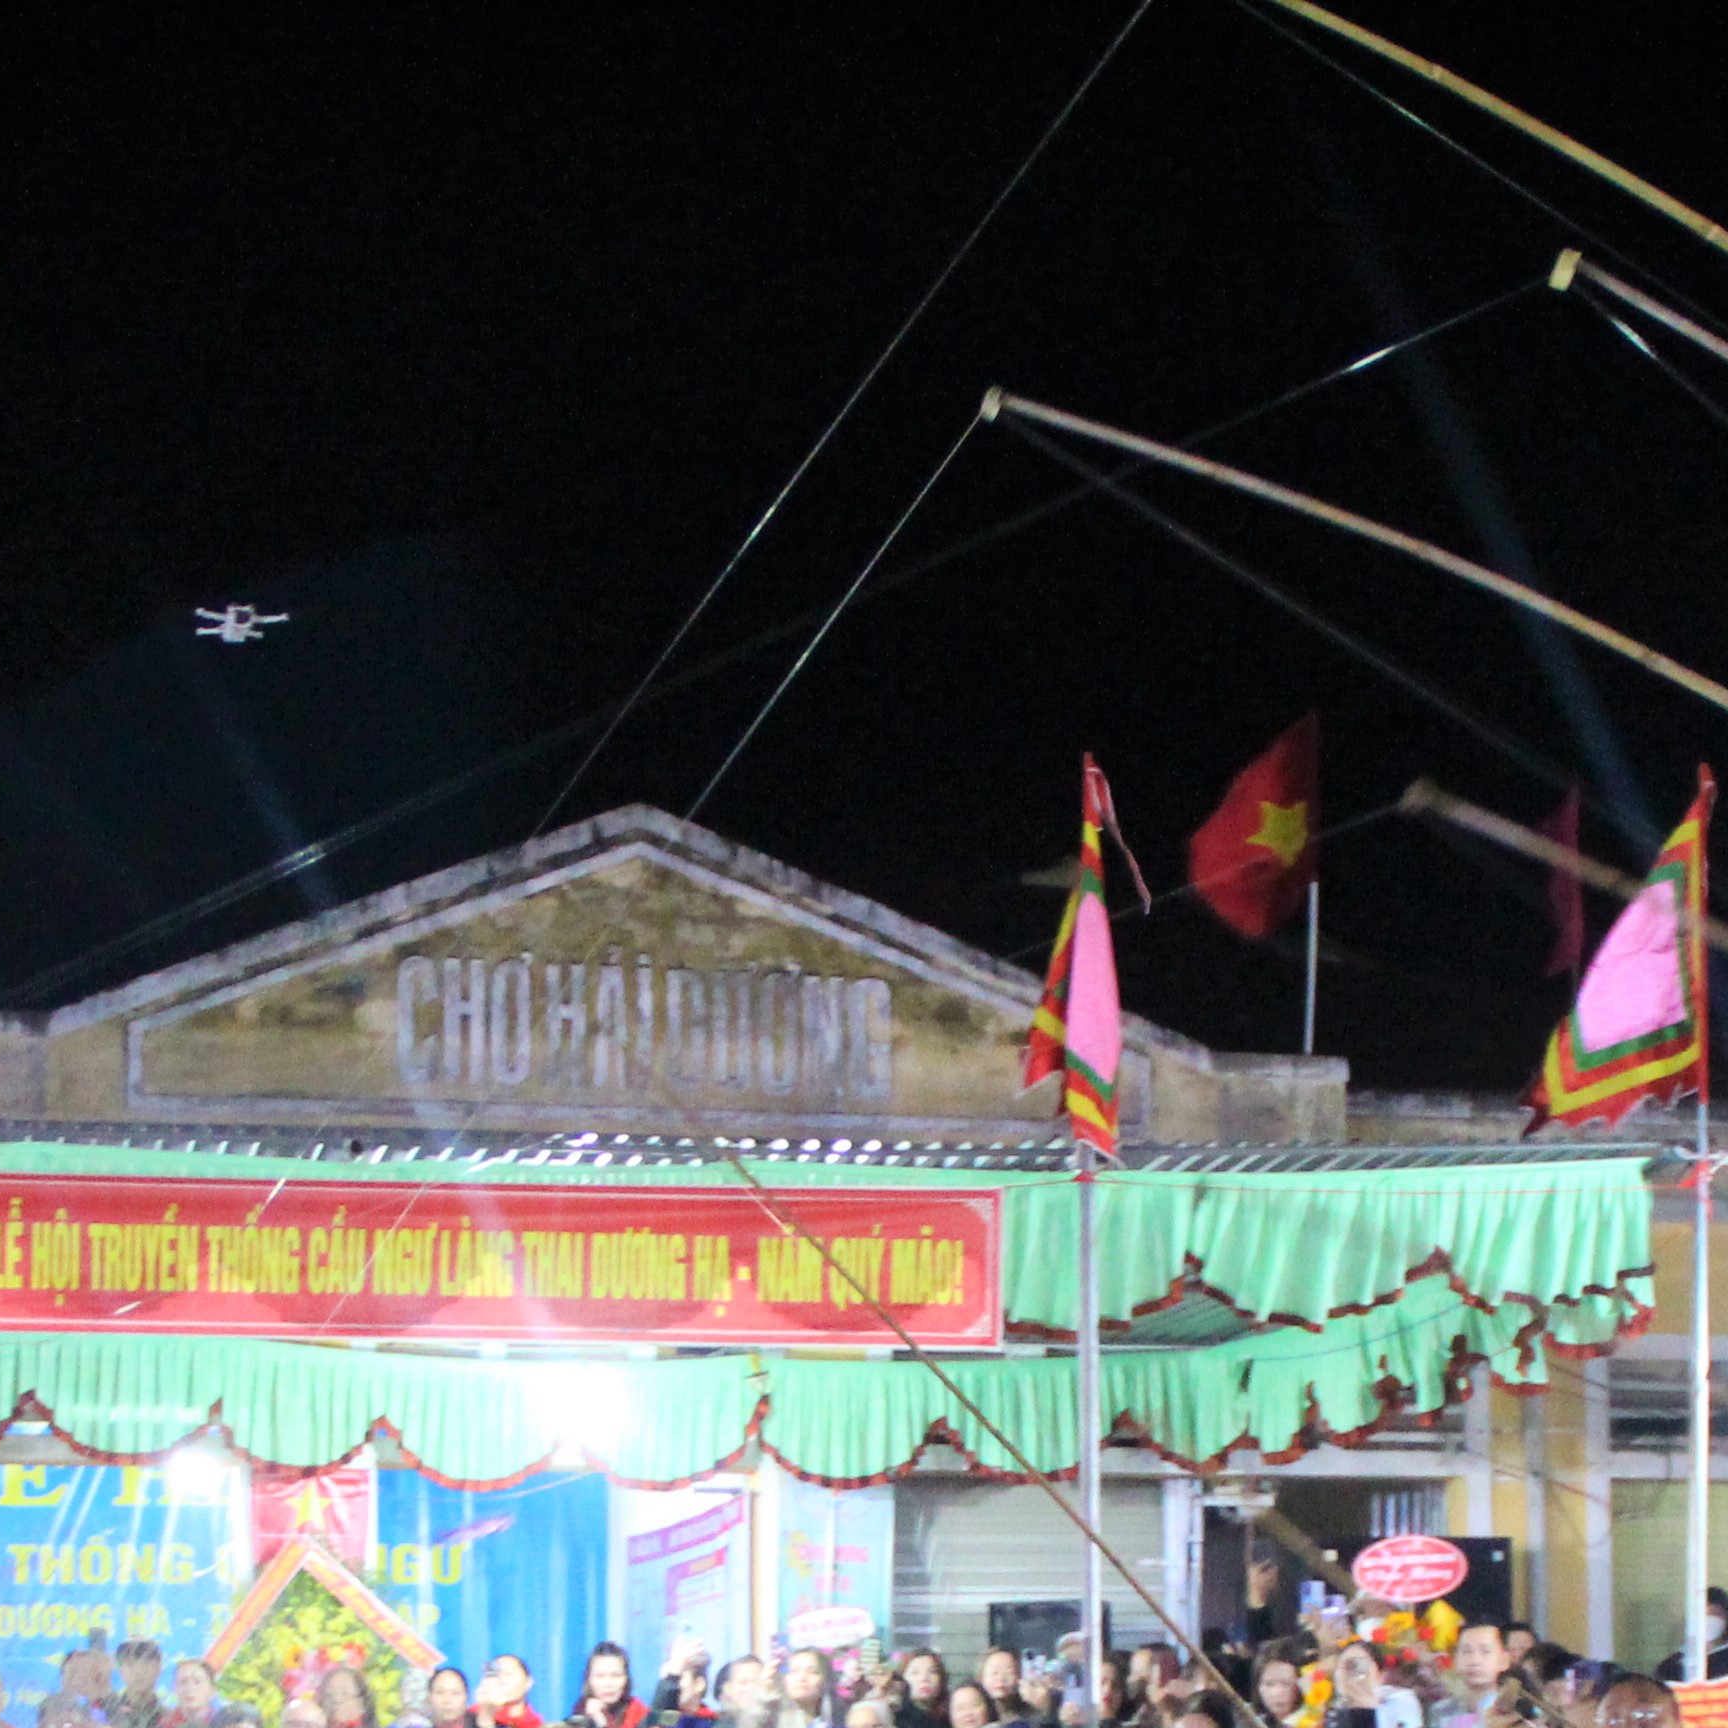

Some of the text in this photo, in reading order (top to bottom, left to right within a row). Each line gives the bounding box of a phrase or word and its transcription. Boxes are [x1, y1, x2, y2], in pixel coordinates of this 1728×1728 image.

[29, 1207, 81, 1306] HỘI
[87, 1202, 200, 1293] TRUYỀN
[205, 1202, 302, 1295] THỐNG
[306, 1204, 368, 1295] CẦU
[373, 1222, 439, 1296] NGƯ
[438, 1215, 515, 1298] LÀNG
[521, 1230, 585, 1299] THAI
[589, 1226, 687, 1300] DƯƠNG
[692, 1235, 733, 1317] HẠ
[757, 1223, 824, 1304] NĂM
[828, 1223, 886, 1312] QUÝ
[889, 1224, 965, 1306] MÃO!
[6, 1527, 196, 1586] THỐNG
